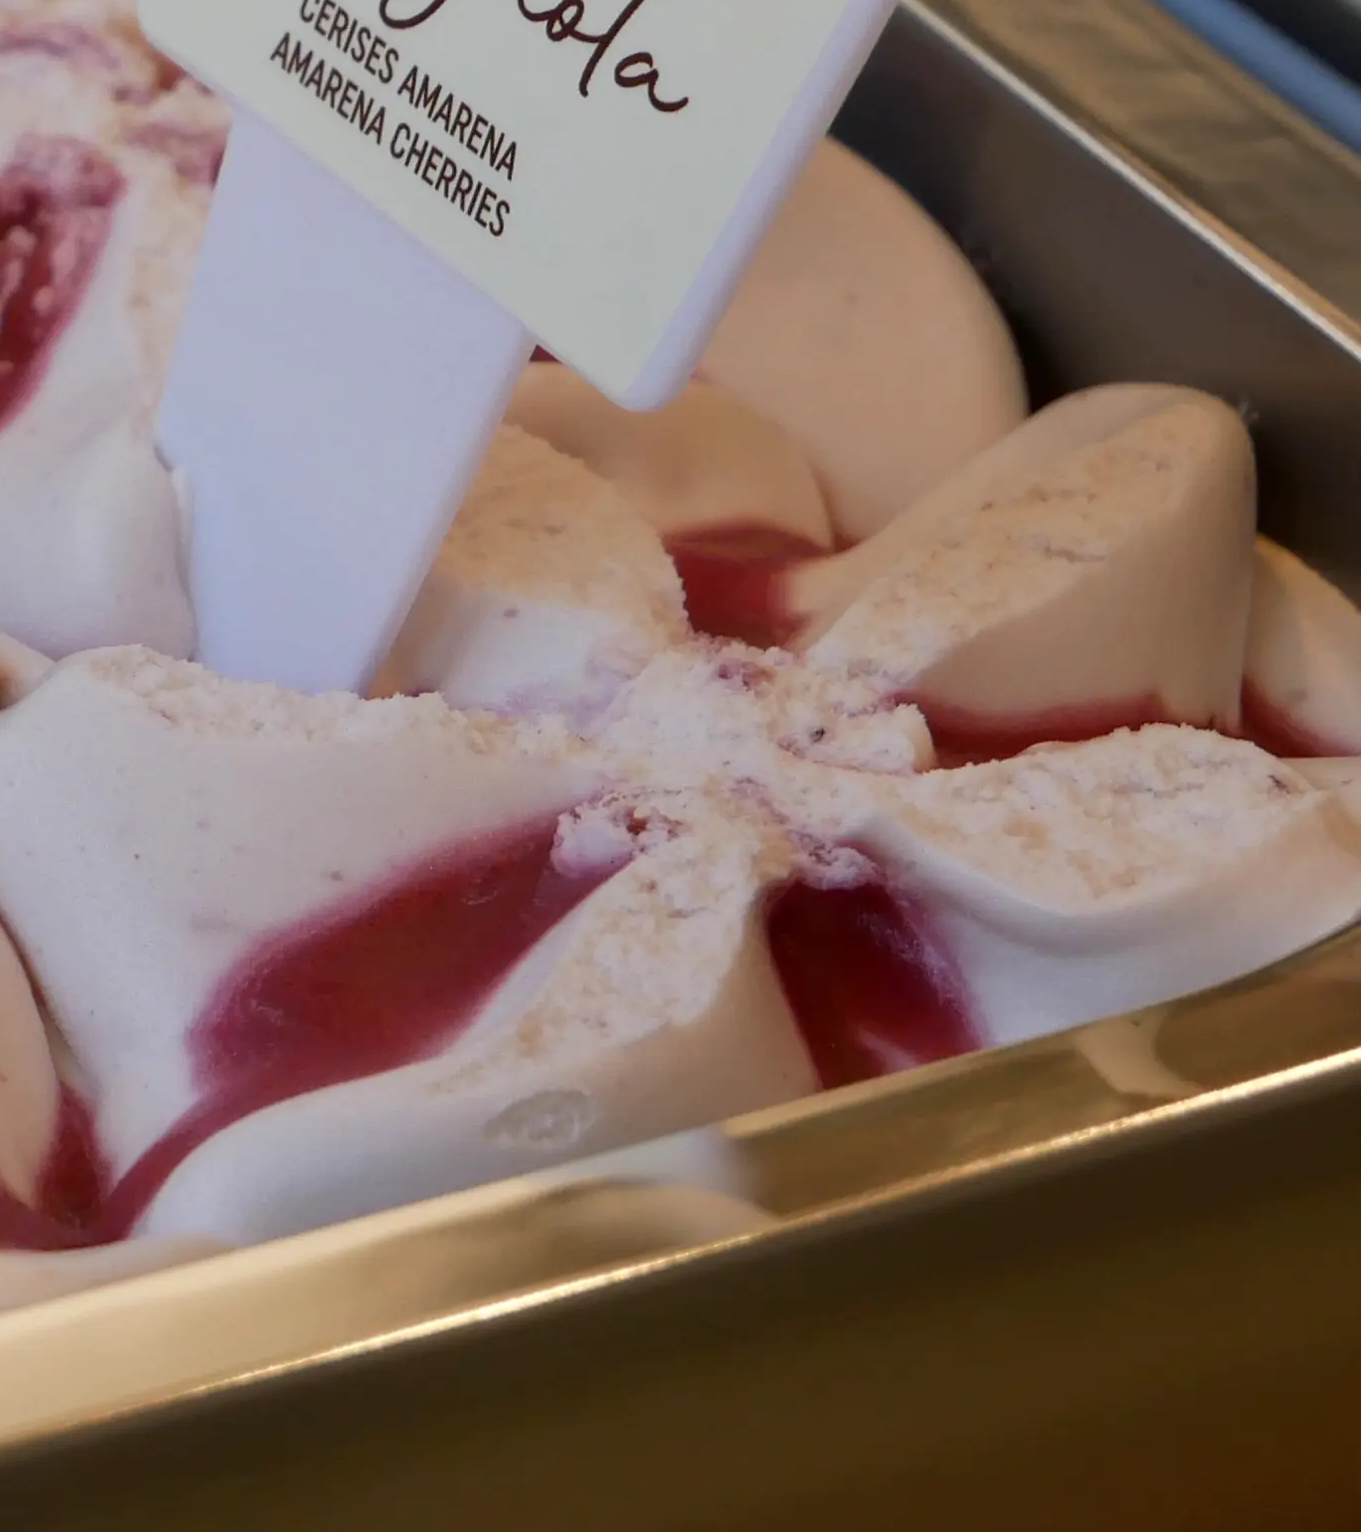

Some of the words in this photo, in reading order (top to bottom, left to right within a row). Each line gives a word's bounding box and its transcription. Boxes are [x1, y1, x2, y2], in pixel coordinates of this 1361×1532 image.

[269, 31, 386, 146] AMARENA
[389, 122, 511, 237] CHERRIES
[397, 64, 517, 182] AMARENA
